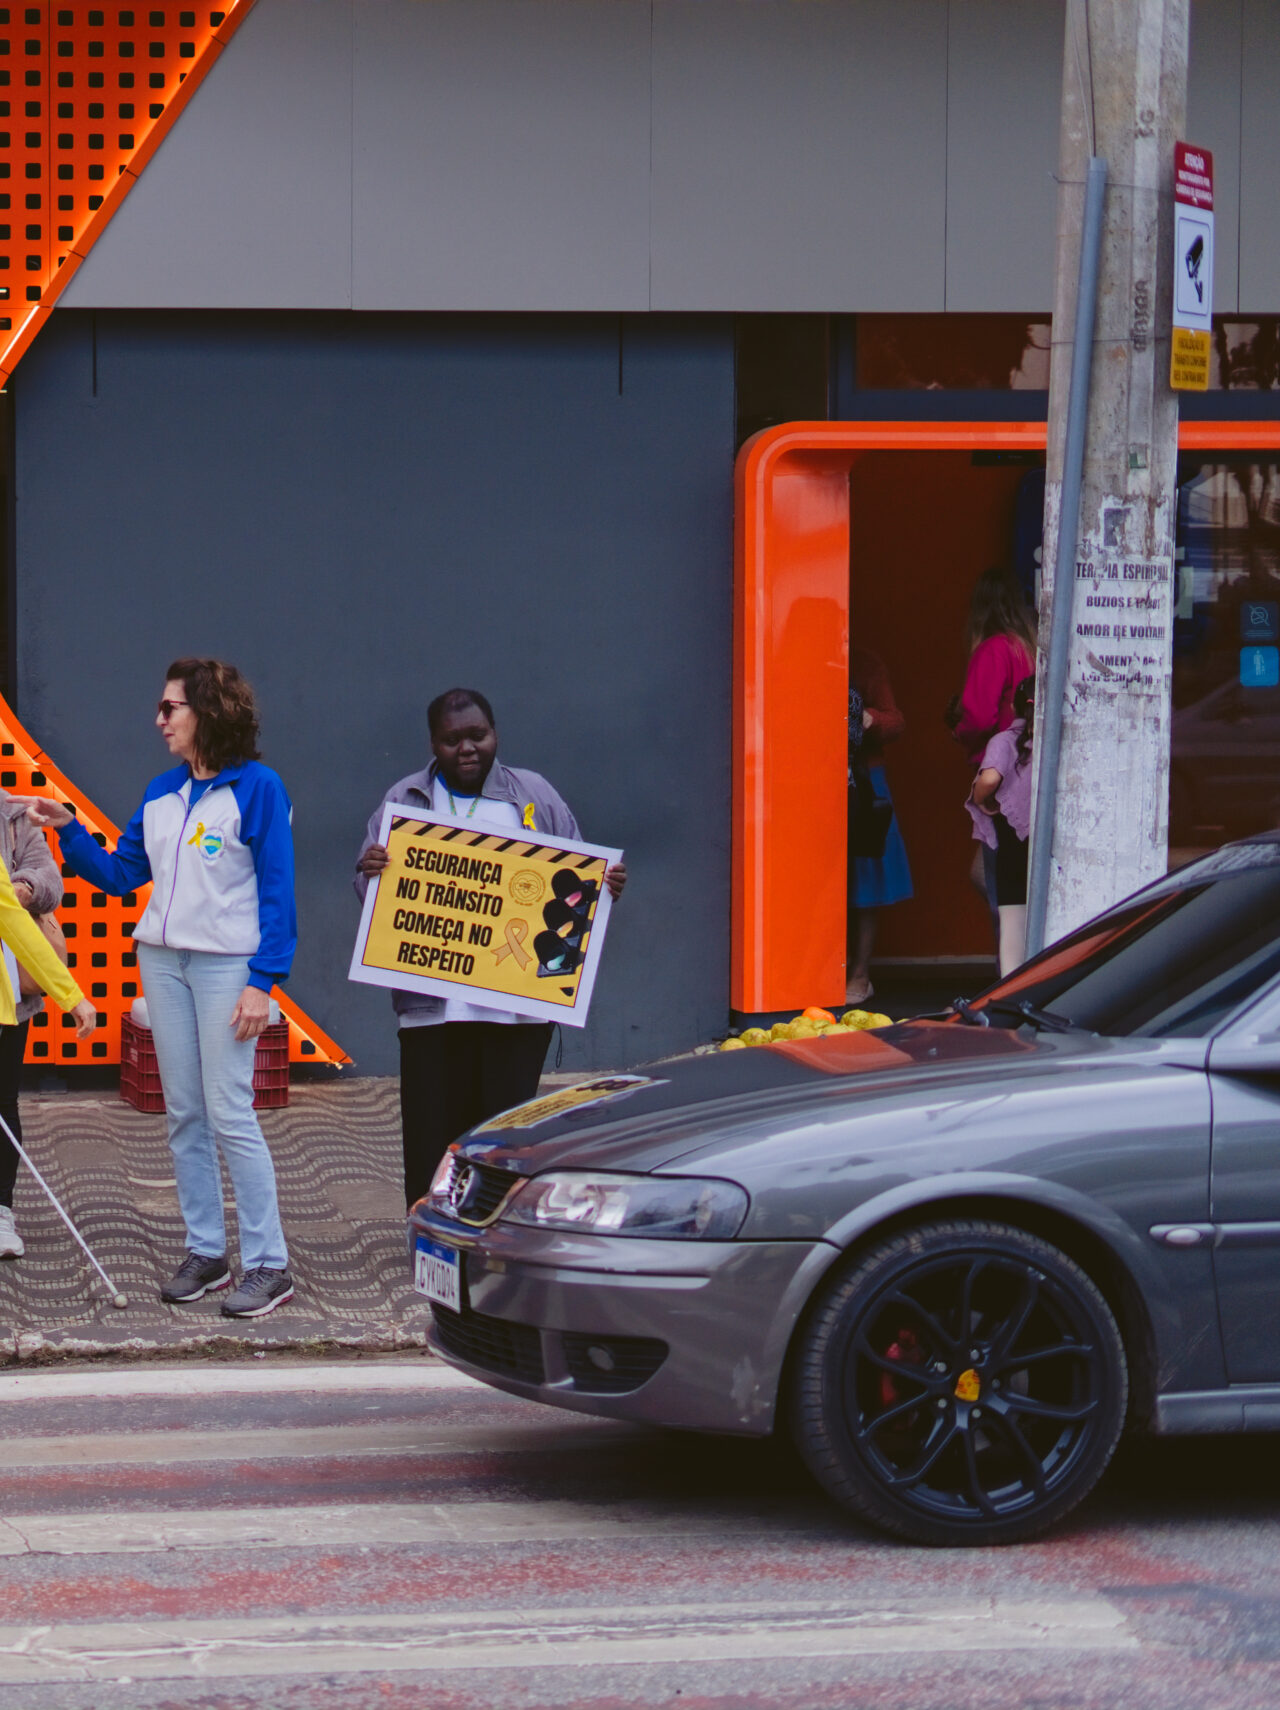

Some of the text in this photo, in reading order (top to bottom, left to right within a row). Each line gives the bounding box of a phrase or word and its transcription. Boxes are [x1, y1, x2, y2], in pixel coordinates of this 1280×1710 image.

[1086, 595, 1124, 608] BUZIOS
[1127, 597, 1133, 607] E
[1076, 623, 1110, 636] AMOR
[404, 846, 503, 890] SEGURANÇA
[396, 877, 419, 901] NO
[424, 881, 504, 917] TRÂNSITO
[392, 908, 494, 947] COMEÇA NO
[396, 941, 475, 976] RESPEITO
